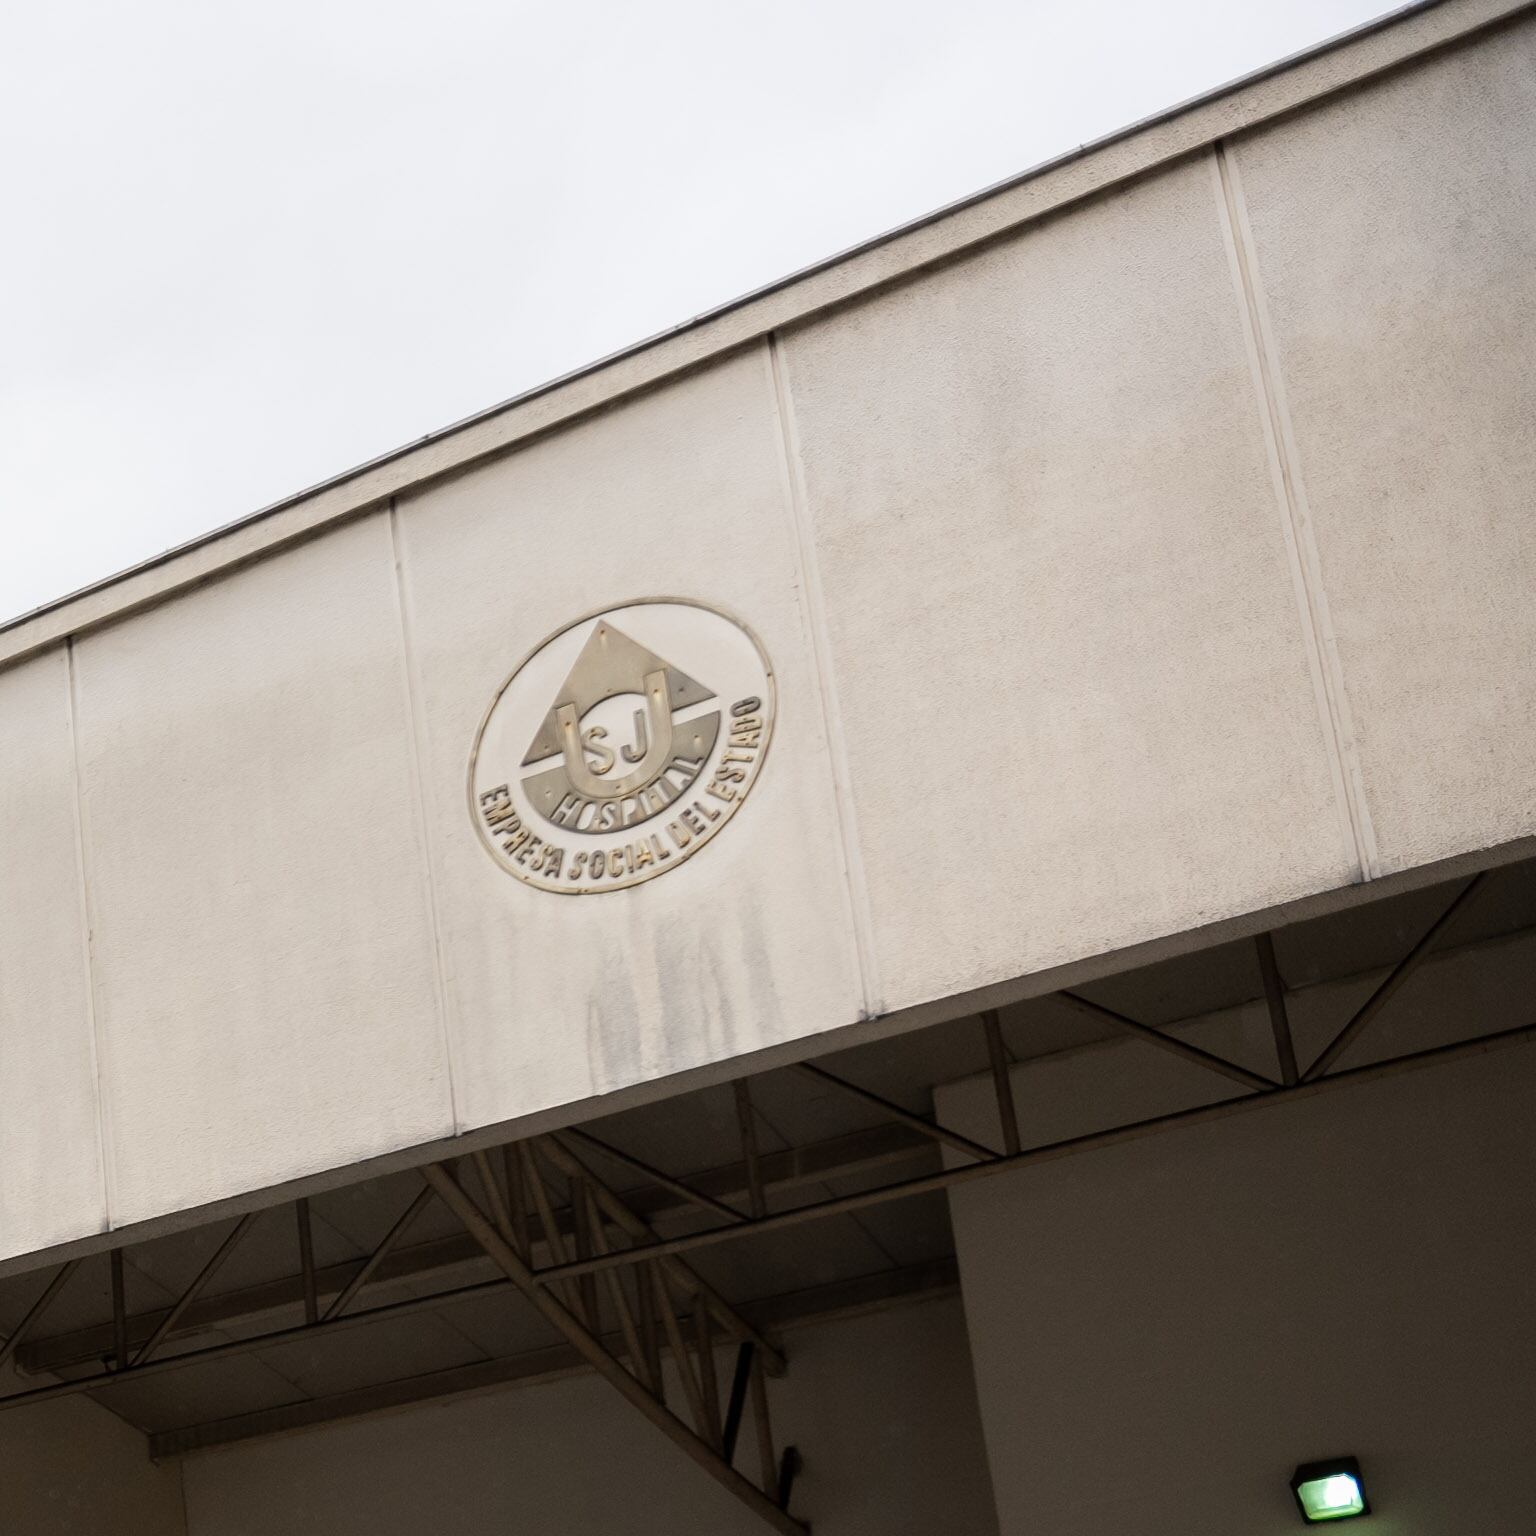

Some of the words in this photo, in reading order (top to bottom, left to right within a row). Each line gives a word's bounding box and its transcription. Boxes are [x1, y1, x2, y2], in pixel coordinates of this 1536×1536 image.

[479, 783, 565, 879] EMPRESA
[568, 833, 670, 880] SOCIAL
[665, 801, 721, 849] DEL
[705, 695, 763, 803] ESTADO
